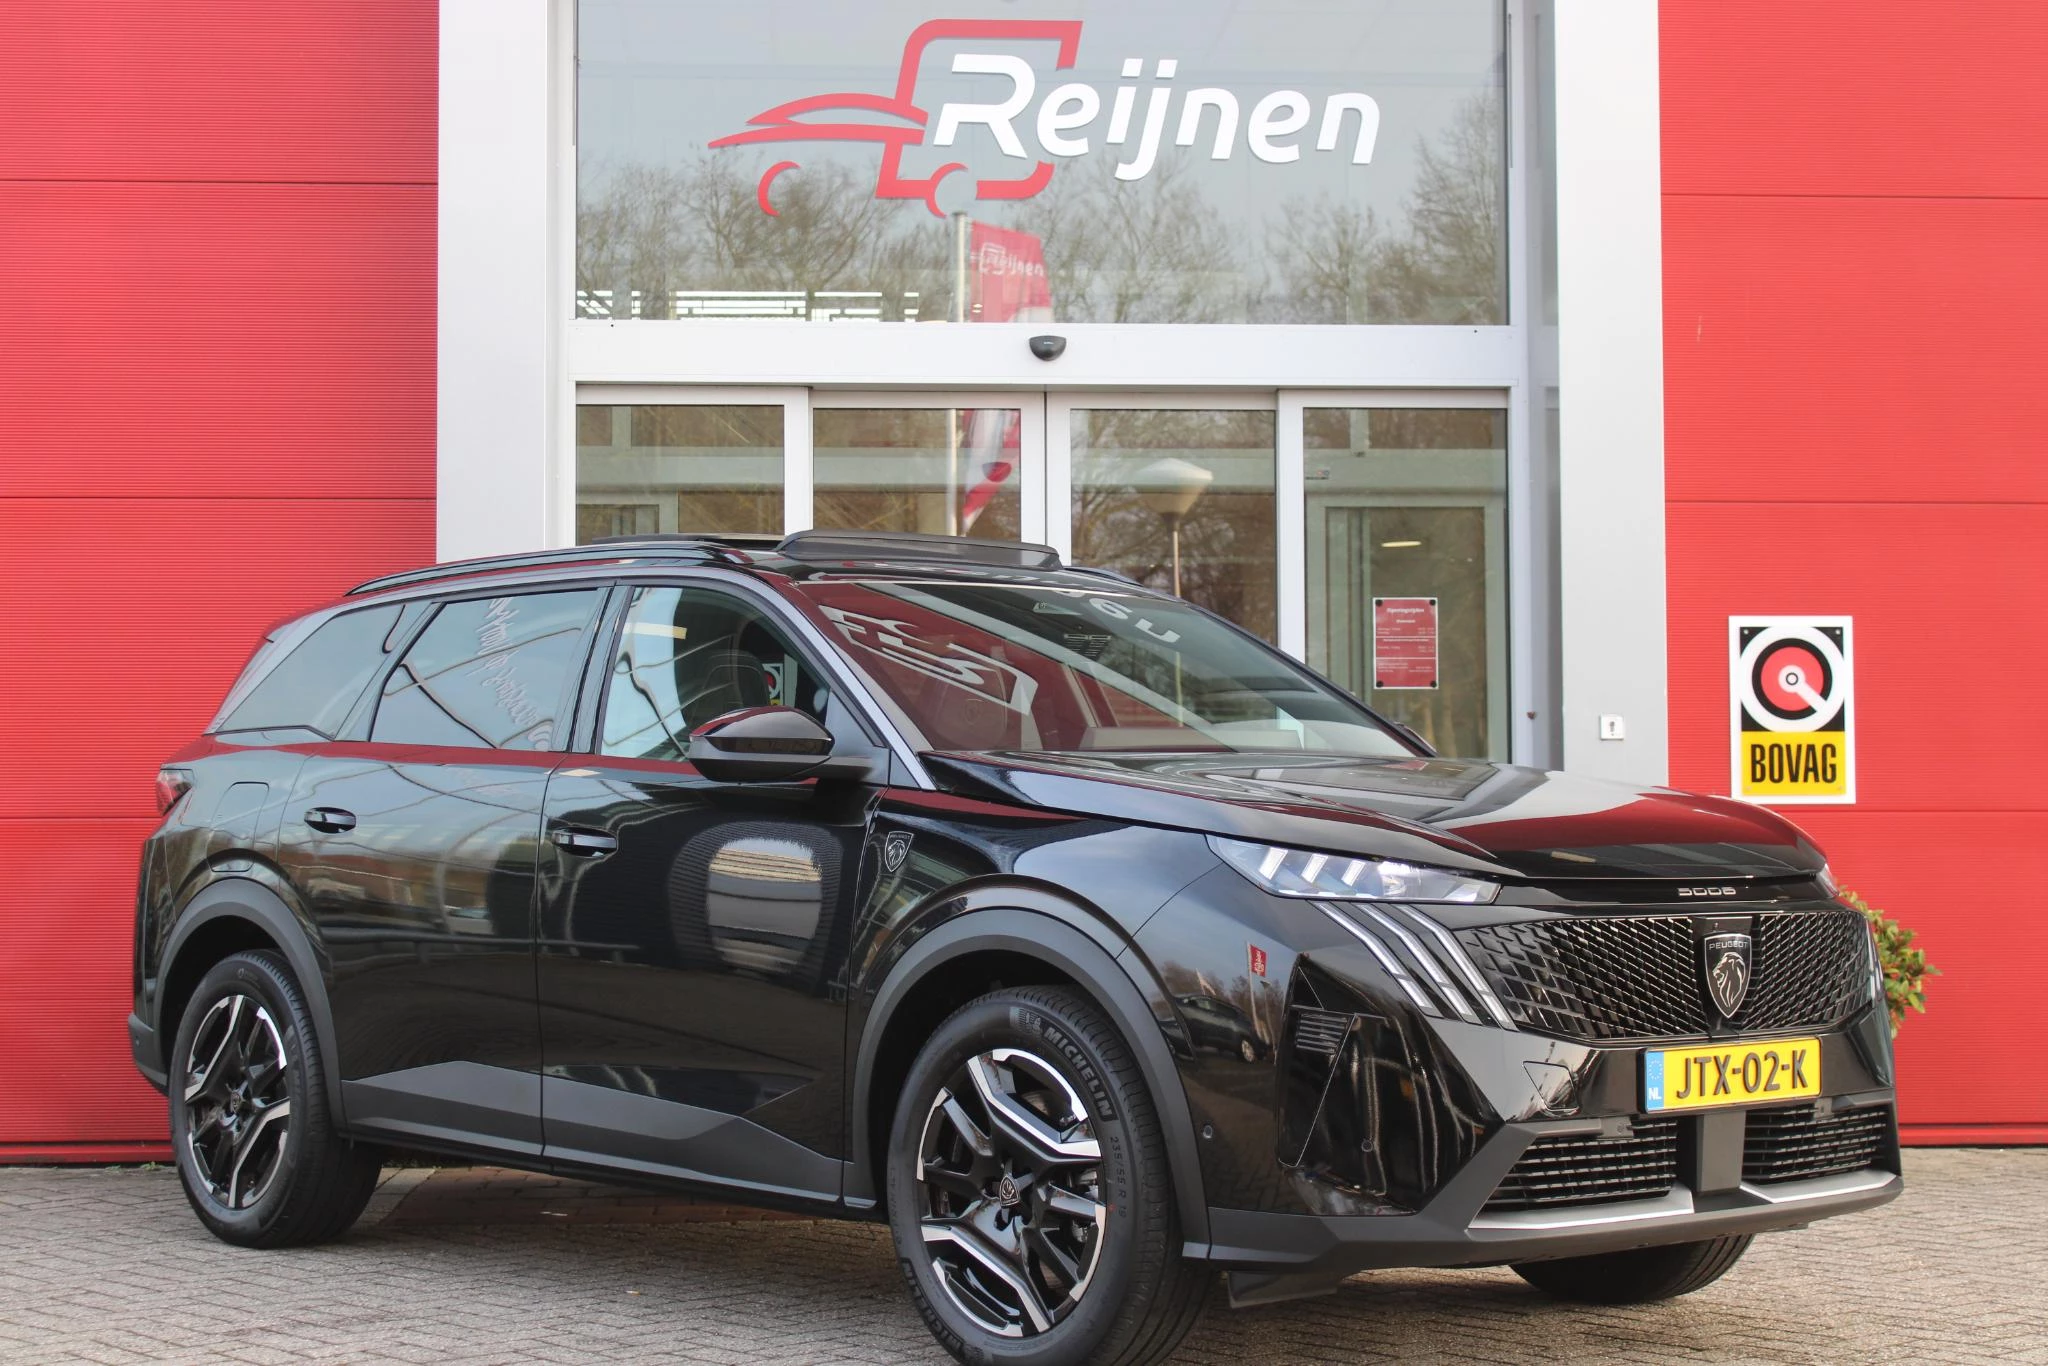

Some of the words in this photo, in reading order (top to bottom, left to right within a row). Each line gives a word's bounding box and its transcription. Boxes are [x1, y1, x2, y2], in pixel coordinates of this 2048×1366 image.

[933, 53, 1381, 181] Reijnen
[1750, 743, 1837, 783] BOVAG
[1708, 940, 1748, 950] PEUGEOT
[1043, 1026, 1113, 1116] MICHELIN
[1648, 1087, 1662, 1100] NL
[1676, 1049, 1808, 1099] JTX-02-K
